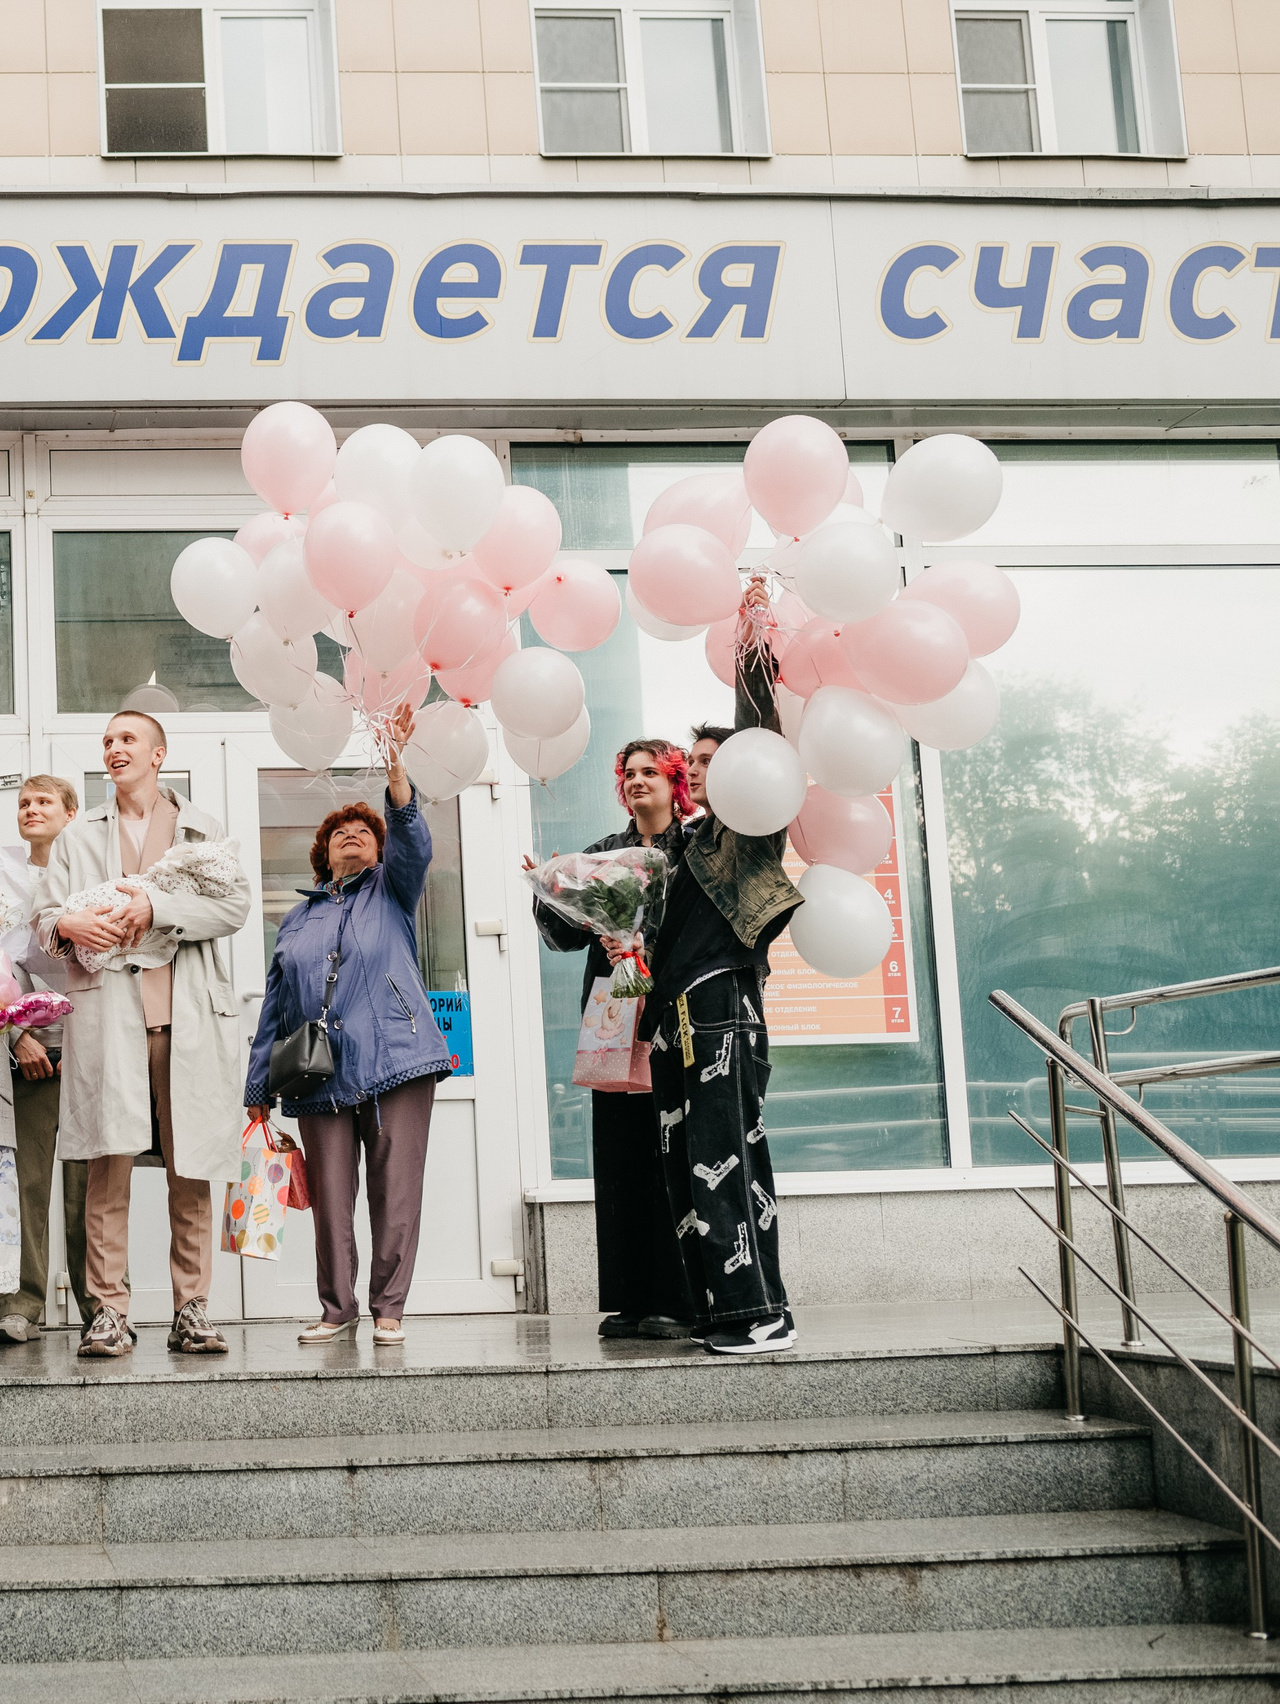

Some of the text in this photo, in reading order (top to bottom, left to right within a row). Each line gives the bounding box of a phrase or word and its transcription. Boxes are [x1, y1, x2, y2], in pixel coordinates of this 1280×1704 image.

[884, 888, 893, 900] 4
[889, 960, 899, 972] 6
[430, 998, 463, 1012] ОРИИ
[892, 1007, 902, 1019] 7
[801, 1023, 821, 1031] БЛОК
